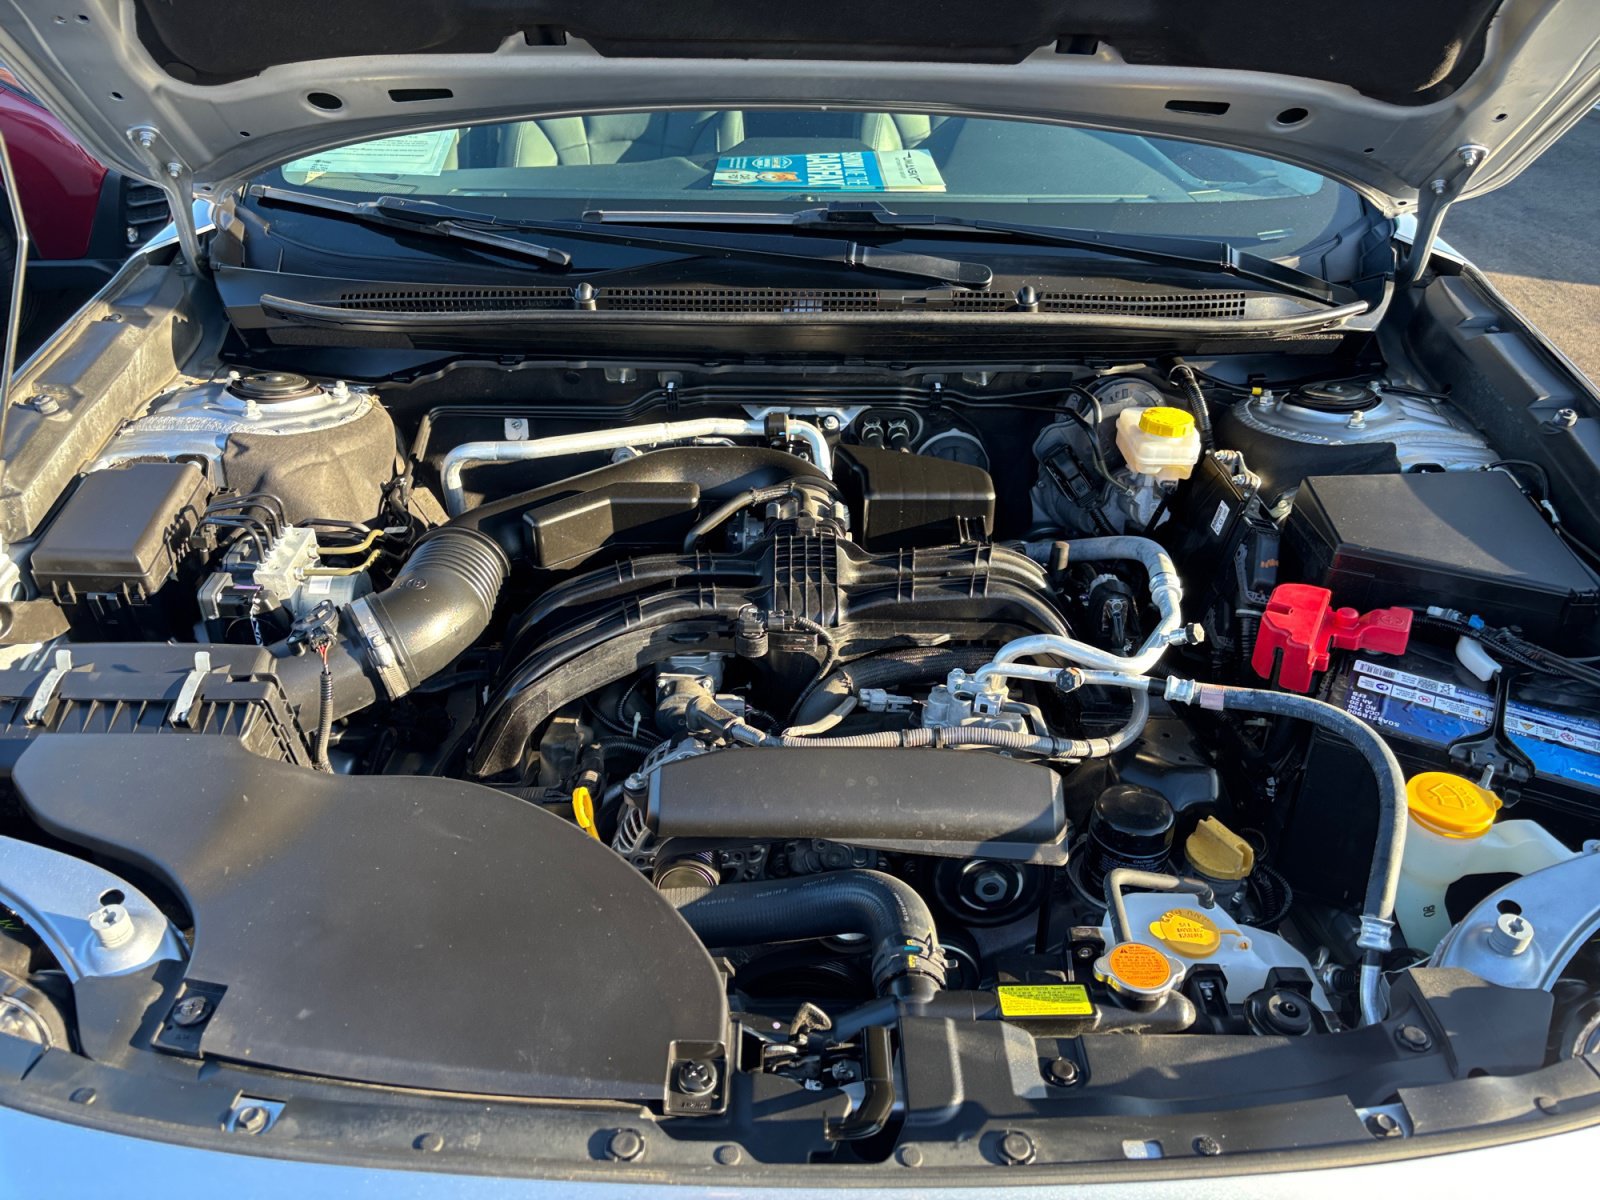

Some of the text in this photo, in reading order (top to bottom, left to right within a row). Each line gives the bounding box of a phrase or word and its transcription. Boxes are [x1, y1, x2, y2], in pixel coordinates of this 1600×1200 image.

[805, 152, 845, 186] CARFAX
[841, 152, 869, 185] SHOW ME THE
[1364, 708, 1380, 717] CCA
[1570, 766, 1600, 780] BARU
